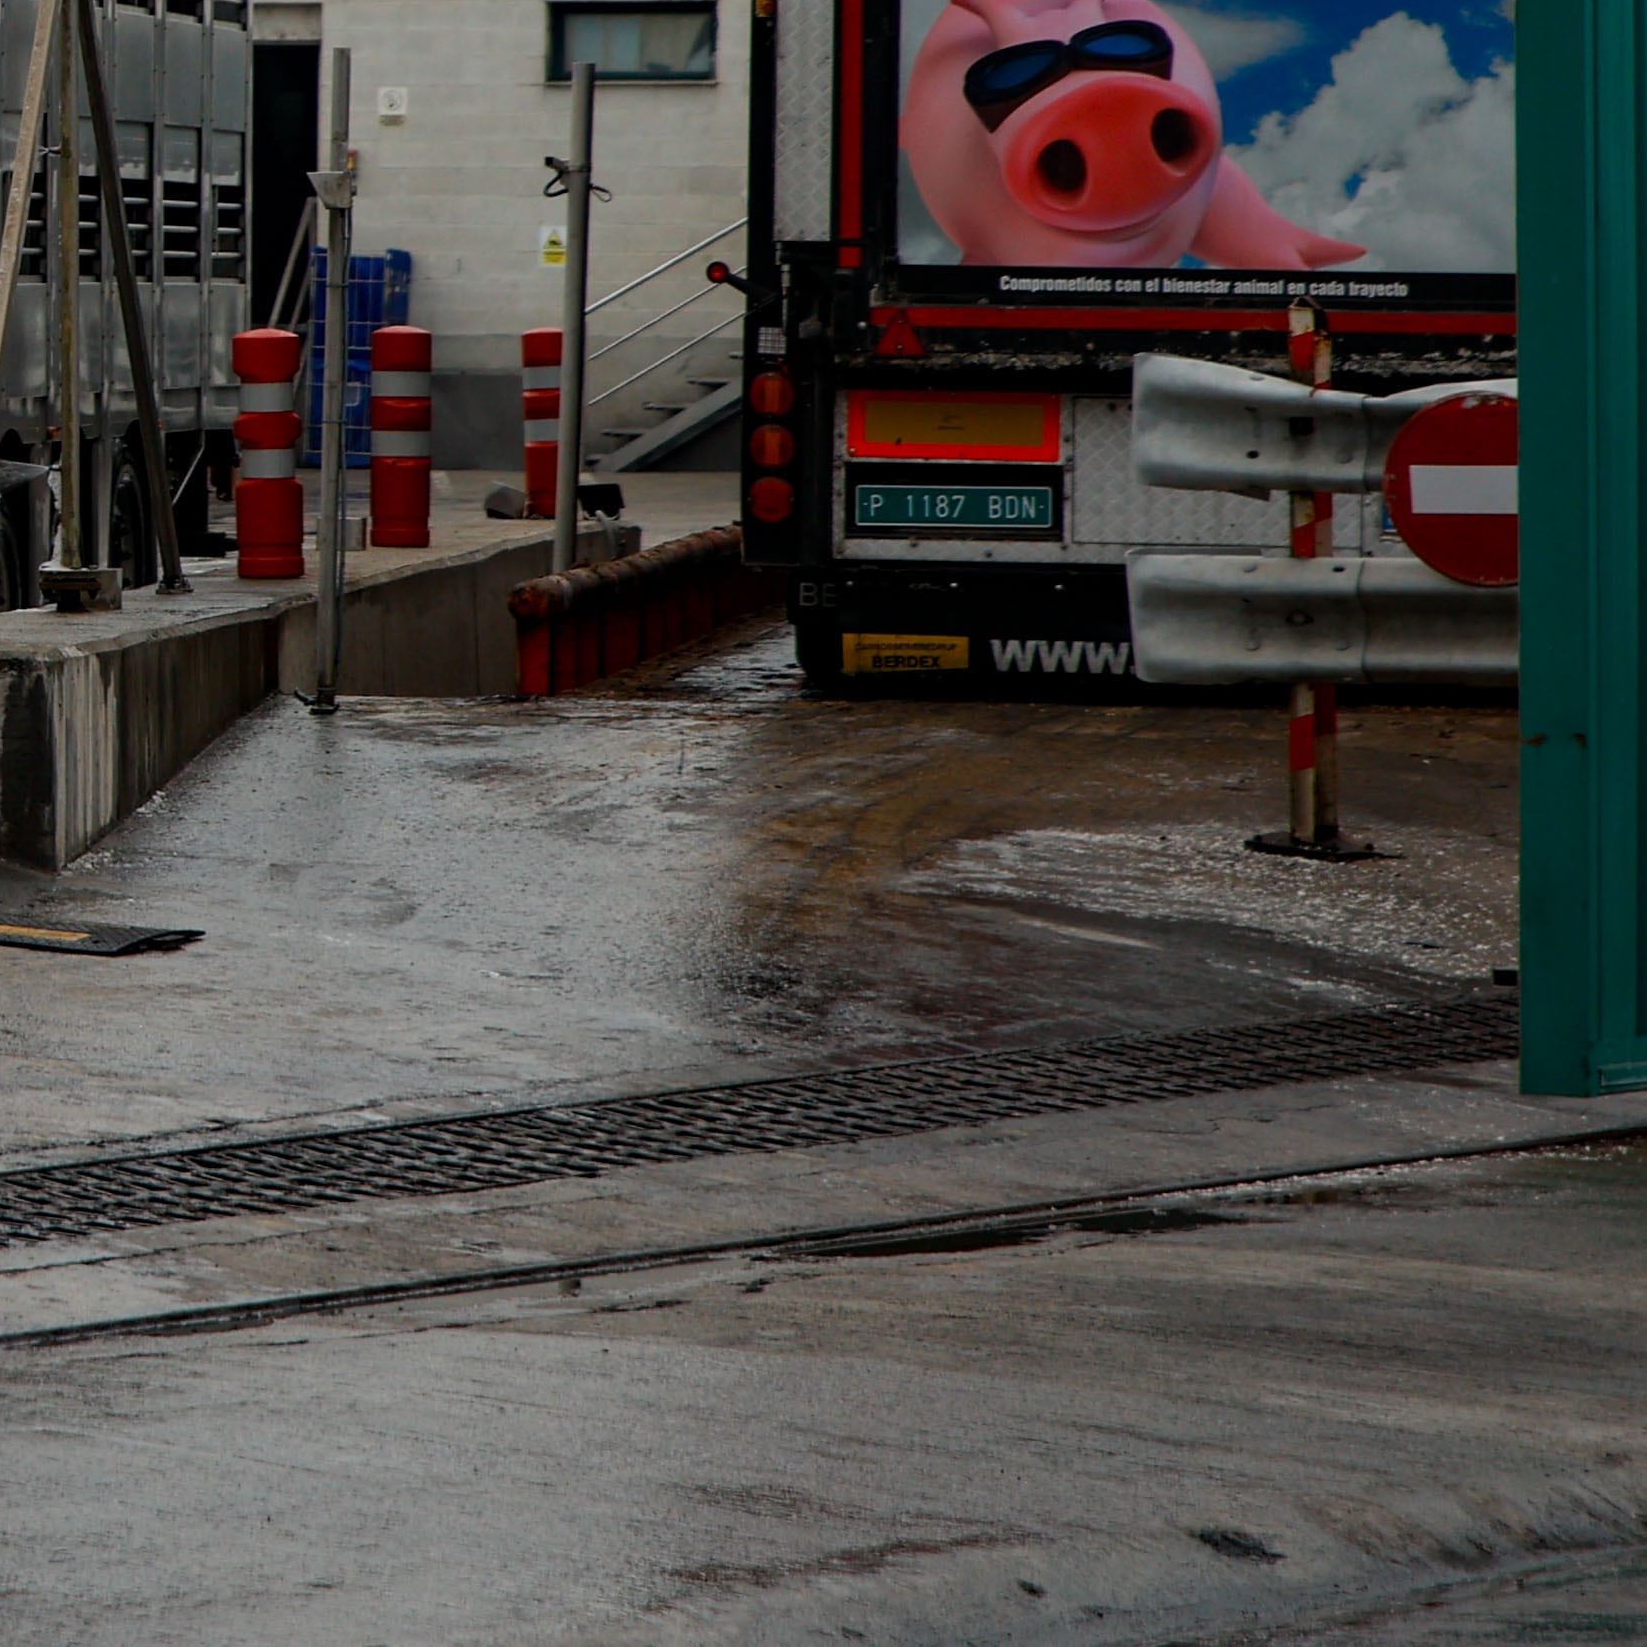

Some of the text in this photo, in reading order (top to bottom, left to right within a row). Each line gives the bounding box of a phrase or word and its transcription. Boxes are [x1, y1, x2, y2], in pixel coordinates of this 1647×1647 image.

[1000, 275, 1408, 298] Comprometidos con el bienestar animal en cada trayecto
[869, 494, 1036, 519] P 1187 BDN
[872, 655, 941, 668] BERDEX
